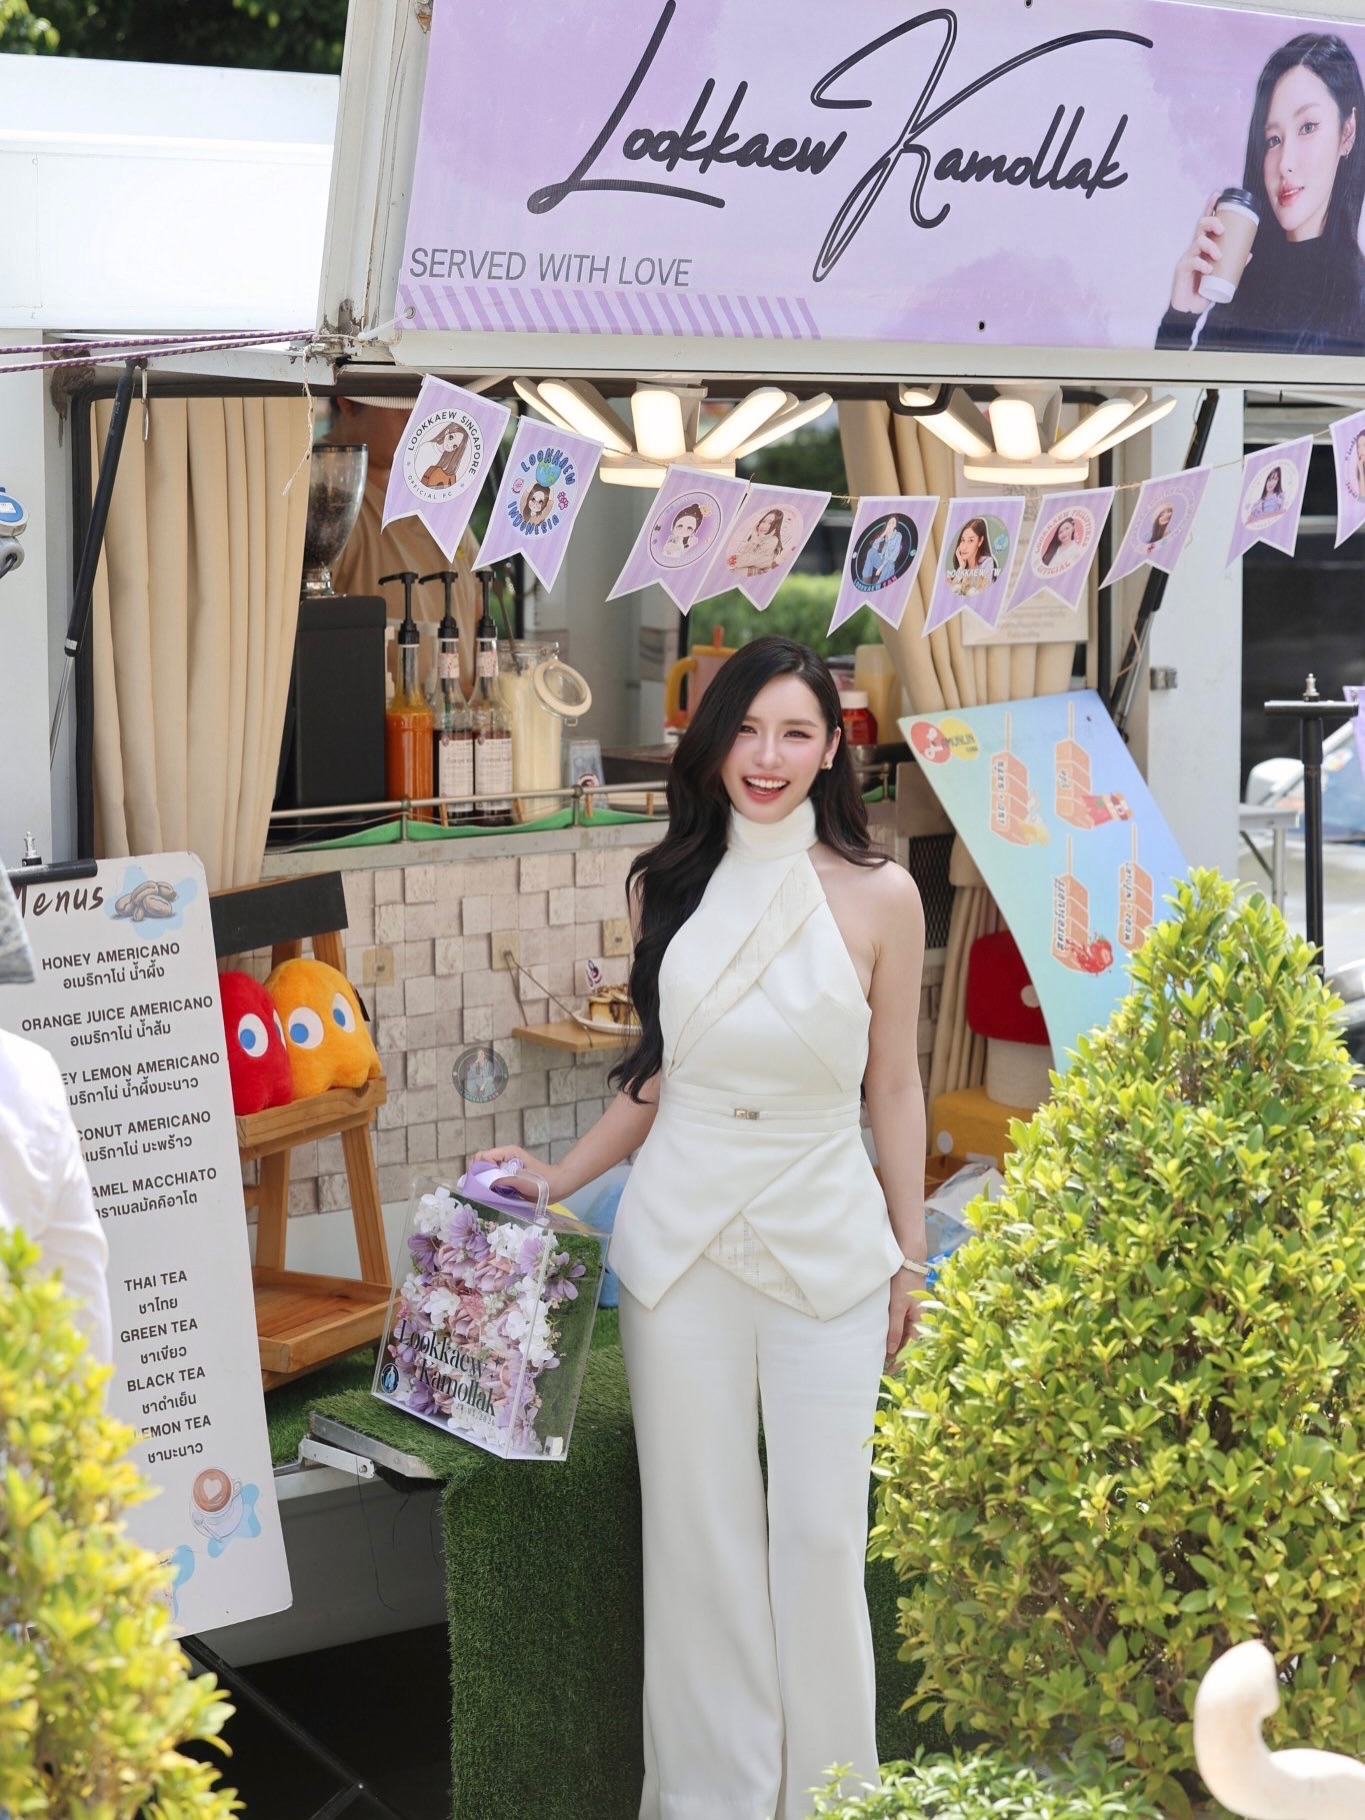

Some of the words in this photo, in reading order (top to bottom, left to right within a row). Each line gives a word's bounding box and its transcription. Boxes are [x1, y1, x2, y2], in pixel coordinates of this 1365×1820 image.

[527, 0, 847, 214] Lookkaew
[810, 8, 1154, 284] Kamollak
[409, 247, 527, 281] SERVED
[538, 252, 610, 284] WITH
[618, 256, 693, 287] LOVE
[408, 410, 457, 451] LOOKKAEW
[461, 415, 480, 475] SINGAPORE
[407, 475, 436, 499] OFFICIAL
[507, 500, 560, 536] INDONESIA
[42, 953, 91, 971] HONEY
[96, 942, 180, 964] AMERICANO
[63, 967, 125, 989] อเมริกาโน่
[130, 960, 165, 980] น้ำผึ้ง
[21, 1012, 82, 1032] ORANGE
[86, 1007, 125, 1024] JUICE
[129, 995, 213, 1018] AMERICANO
[70, 1024, 133, 1047] อเมริกาโน่
[136, 1018, 171, 1038] น้ำส้ม
[82, 1064, 132, 1083] LEMON
[136, 1052, 220, 1075] AMERICANO
[69, 1084, 118, 1106] มริกาโน่
[122, 1075, 199, 1098] น้ำผึ้งมะนาว
[77, 1123, 122, 1142] CONUT
[128, 1110, 211, 1135] AMERICANO
[83, 1140, 138, 1163] เมริกาโน่
[142, 1133, 193, 1153] มะพร้าว
[92, 1182, 129, 1198] AMEL
[132, 1167, 217, 1192] MACCHIATO
[124, 1275, 157, 1292] THAI
[160, 1270, 187, 1285] TEA
[139, 1296, 178, 1314] ชาไทย
[120, 1323, 167, 1343] GREEN
[171, 1318, 198, 1333] TEA
[140, 1345, 187, 1364] ชาเขียว
[399, 1319, 482, 1379] Lookkaew
[127, 1372, 175, 1392] BLACK
[179, 1366, 206, 1381] TEA
[419, 1358, 495, 1417] Kamollak
[142, 1391, 197, 1414] ชาดำเย็น
[185, 1415, 211, 1430] TEA
[148, 1442, 203, 1463] ชามะนาว
